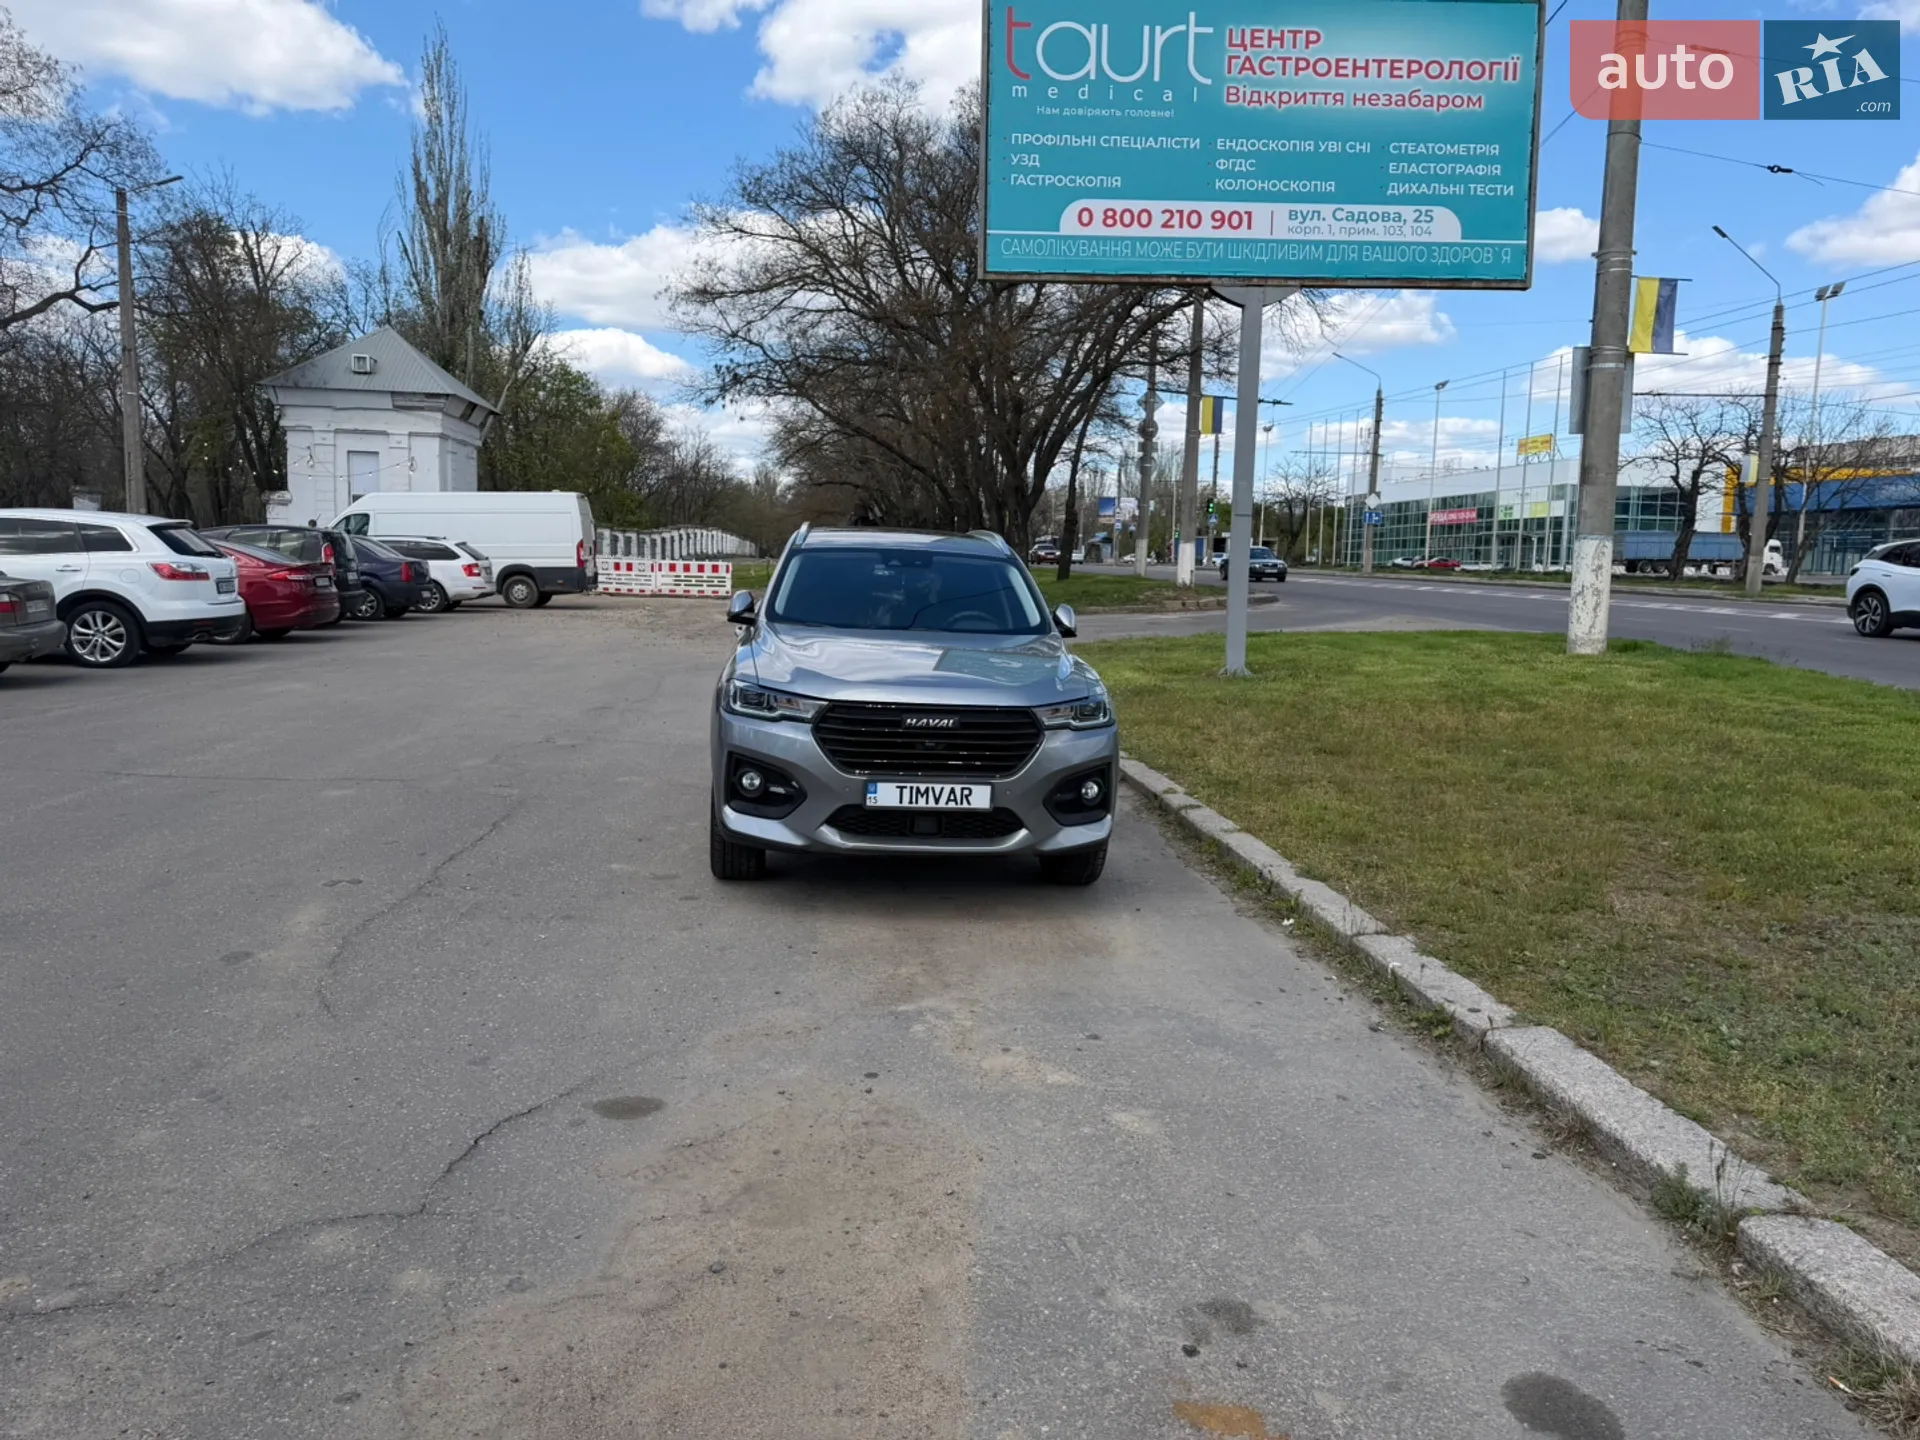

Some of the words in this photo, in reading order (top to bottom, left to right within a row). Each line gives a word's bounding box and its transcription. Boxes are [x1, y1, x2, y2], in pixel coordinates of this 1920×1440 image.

[1006, 6, 1214, 85] taurt
[1227, 28, 1322, 51] ЦЕНТР
[1225, 55, 1520, 81] ГАСТРОЕНТЕРОЛОГІЇ
[1012, 84, 1198, 102] medical
[1225, 85, 1345, 109] Відкриття
[1352, 89, 1483, 112] незабаром
[1036, 105, 1060, 115] Нам
[1062, 107, 1121, 117] довіряють
[1010, 133, 1096, 147] ПРОФІЛЬНІ
[1100, 135, 1200, 149] СПЕЦІАЛІСТИ
[1216, 138, 1314, 152] ЕНДОСКОПІЯ
[1318, 141, 1342, 152] УВІ
[1345, 141, 1371, 153] СНІ
[1389, 142, 1500, 156] СТЕАТОМЕТРІЯ
[1010, 153, 1040, 168] УЗД
[1215, 158, 1256, 172] ФГДС
[1388, 162, 1501, 176] ЕЛАСТОГРАФІЯ
[1010, 174, 1122, 188] ГАСТРОСКОПІЯ
[1215, 178, 1336, 193] КОЛОНОСКОПІЯ
[1387, 182, 1465, 196] ДИХАЛЬНІ
[1468, 184, 1515, 196] ТЕСТИ
[1077, 206, 1094, 228] 0
[1101, 207, 1153, 229] 800
[1160, 208, 1203, 230] 210
[1210, 210, 1253, 231] 901
[1287, 208, 1327, 224] вул.
[1332, 207, 1408, 226] Садова,
[1412, 208, 1435, 224] 25
[1287, 224, 1324, 237] корп.
[1339, 226, 1380, 238] прим.
[1383, 225, 1407, 238] 103,
[1410, 225, 1433, 238] 104
[1001, 238, 1132, 257] САМОЛІКУВАННЯ
[1136, 241, 1183, 258] МОЖЕ
[1186, 242, 1224, 259] БУТИ
[1227, 243, 1324, 263] ШКІДЛИВИМ
[1326, 245, 1359, 264] ДЛЯ
[1362, 245, 1427, 263] ВАШОГО
[905, 718, 955, 728] HAVAL
[895, 785, 973, 806] TIMVAR
